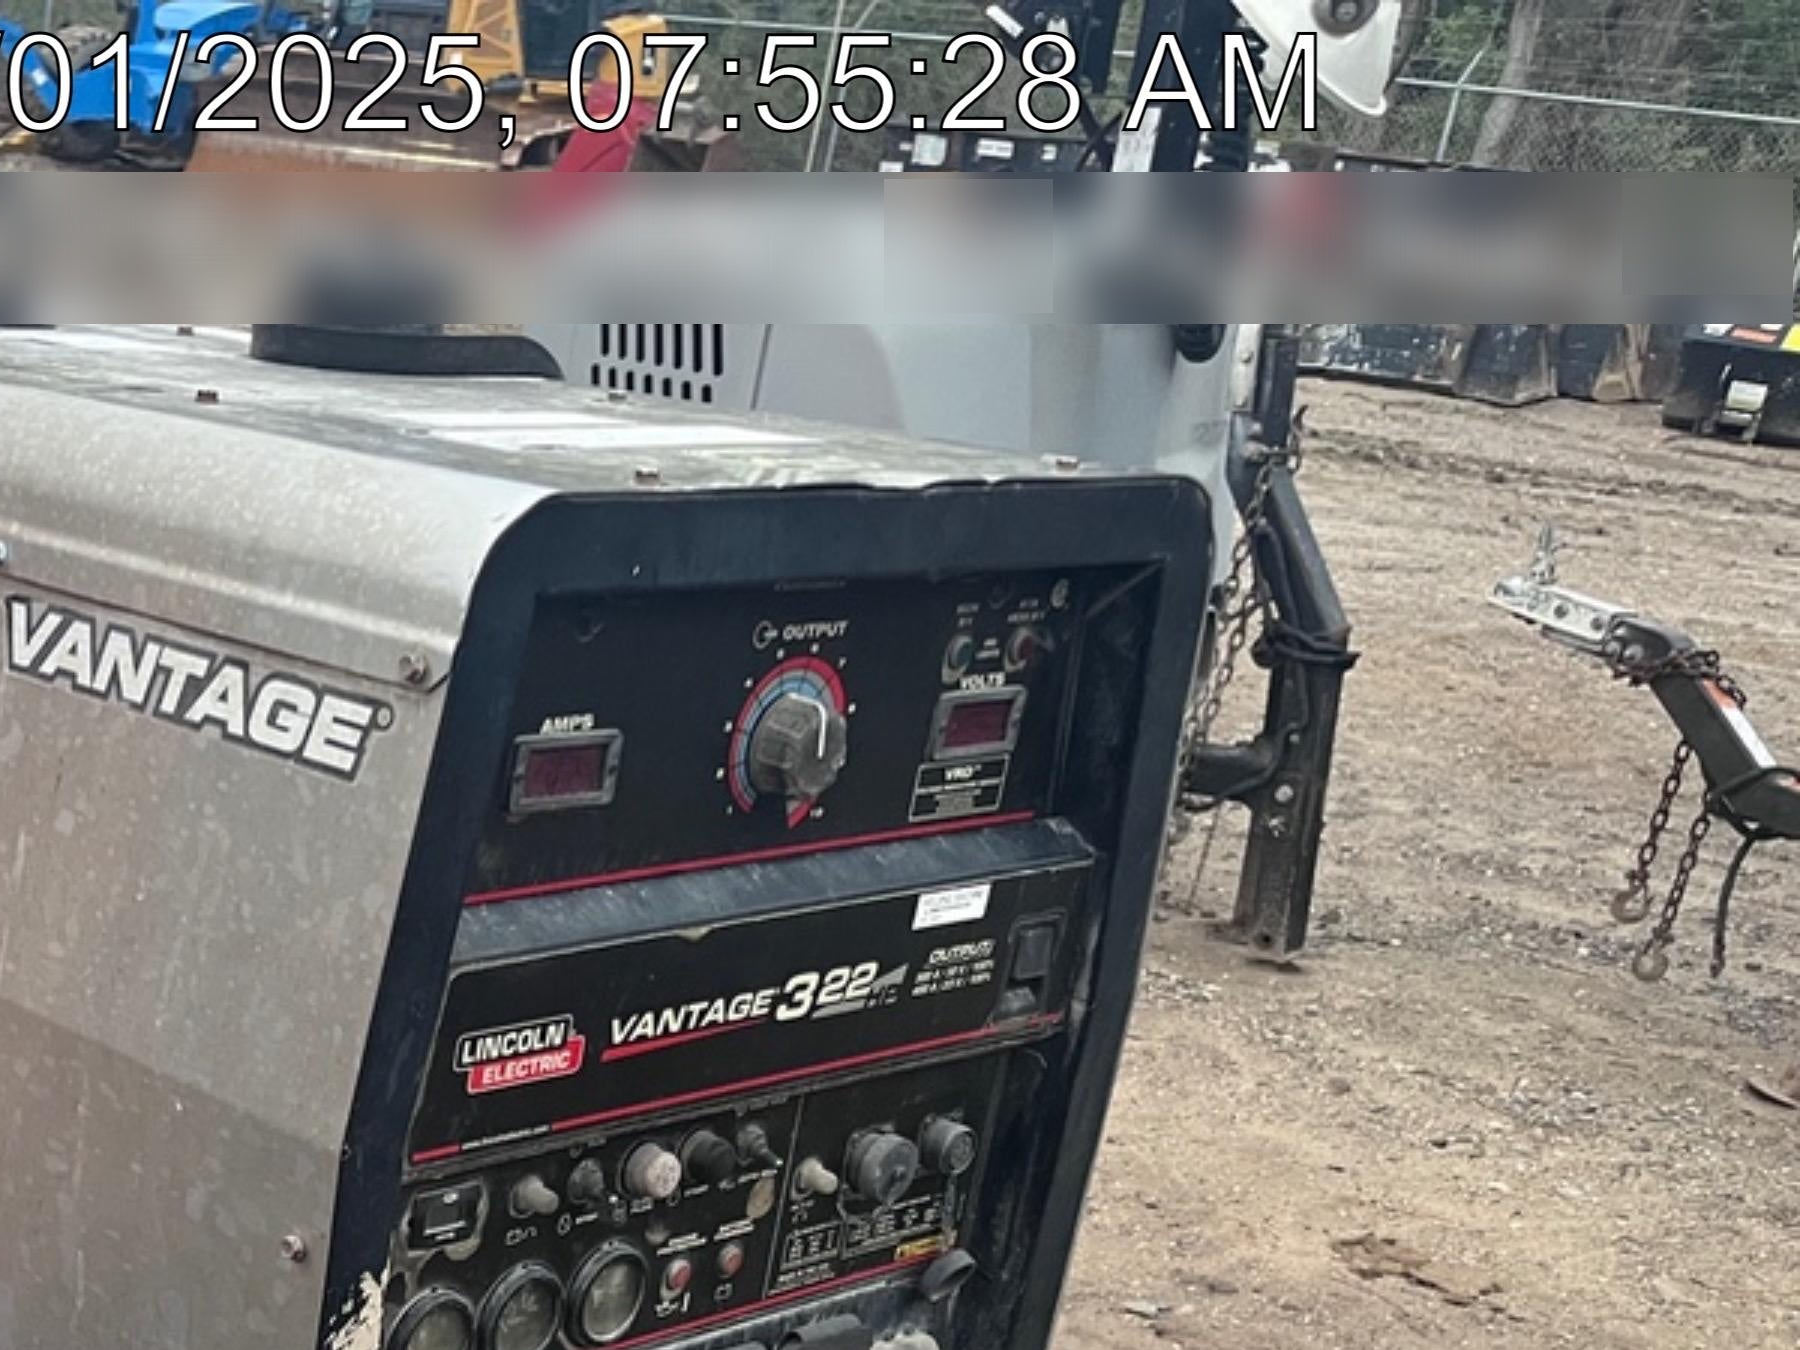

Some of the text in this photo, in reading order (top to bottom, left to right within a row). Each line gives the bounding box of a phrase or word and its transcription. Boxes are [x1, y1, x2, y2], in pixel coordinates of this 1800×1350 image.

[783, 621, 849, 641] OUTPUT
[5, 596, 375, 778] VANTAGE
[960, 670, 1005, 690] VOLTS
[540, 713, 596, 734] AMPS
[609, 990, 777, 1046] VANTAGE
[774, 961, 881, 1022] 322
[460, 1022, 567, 1064] LINCOLN
[481, 1050, 573, 1086] ELECTRIC
